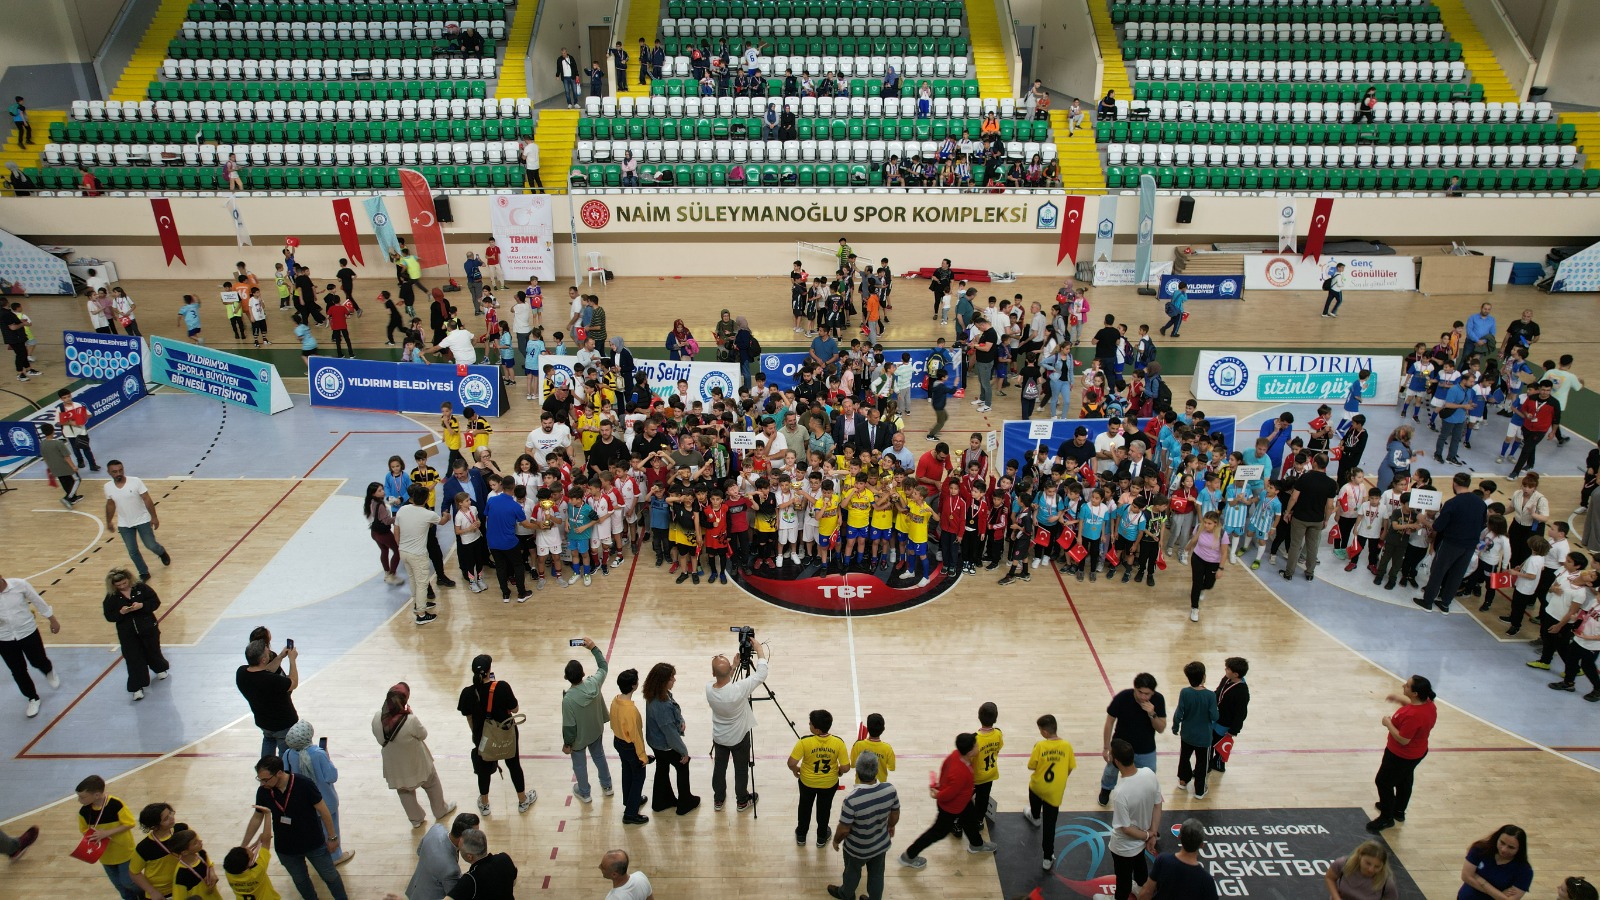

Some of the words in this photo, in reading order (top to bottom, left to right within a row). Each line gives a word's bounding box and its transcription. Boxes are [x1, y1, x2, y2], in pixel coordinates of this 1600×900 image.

[616, 202, 671, 222] NAİM
[676, 201, 848, 222] SÜLEYMANOĞLU
[853, 206, 906, 223] SPOR
[912, 202, 1028, 223] KOMPLEKSİ
[509, 235, 538, 244] TBMM
[1351, 259, 1373, 269] Genç
[1351, 269, 1398, 278] Gönüllüler
[99, 339, 128, 347] BELEDİYESİ
[187, 353, 230, 372] YILDIRIM'DA
[529, 348, 536, 358] 4
[657, 361, 692, 382] Şehri
[1262, 354, 1373, 373] YILDIRIM
[176, 363, 205, 378] SPORLA
[205, 370, 240, 386] BÜYÜYEN
[171, 373, 185, 386] BİR
[184, 377, 207, 392] NESİL
[207, 384, 248, 403] YETİŞİYOR
[348, 377, 392, 389] YILDIRIM
[392, 379, 454, 392] BELEDİYESİ
[1264, 374, 1320, 395] sizinle
[91, 391, 120, 410] YILDIRIM
[94, 398, 121, 417] BELEDİYESİ
[817, 585, 873, 599] TBF
[813, 759, 832, 774] 13
[1044, 762, 1056, 783] 6
[1203, 825, 1258, 836] ÜRKİYE
[1261, 824, 1330, 836] SİGORTA
[1182, 839, 1295, 859] ÜRKİYE
[1200, 860, 1335, 877] ASKETBO
